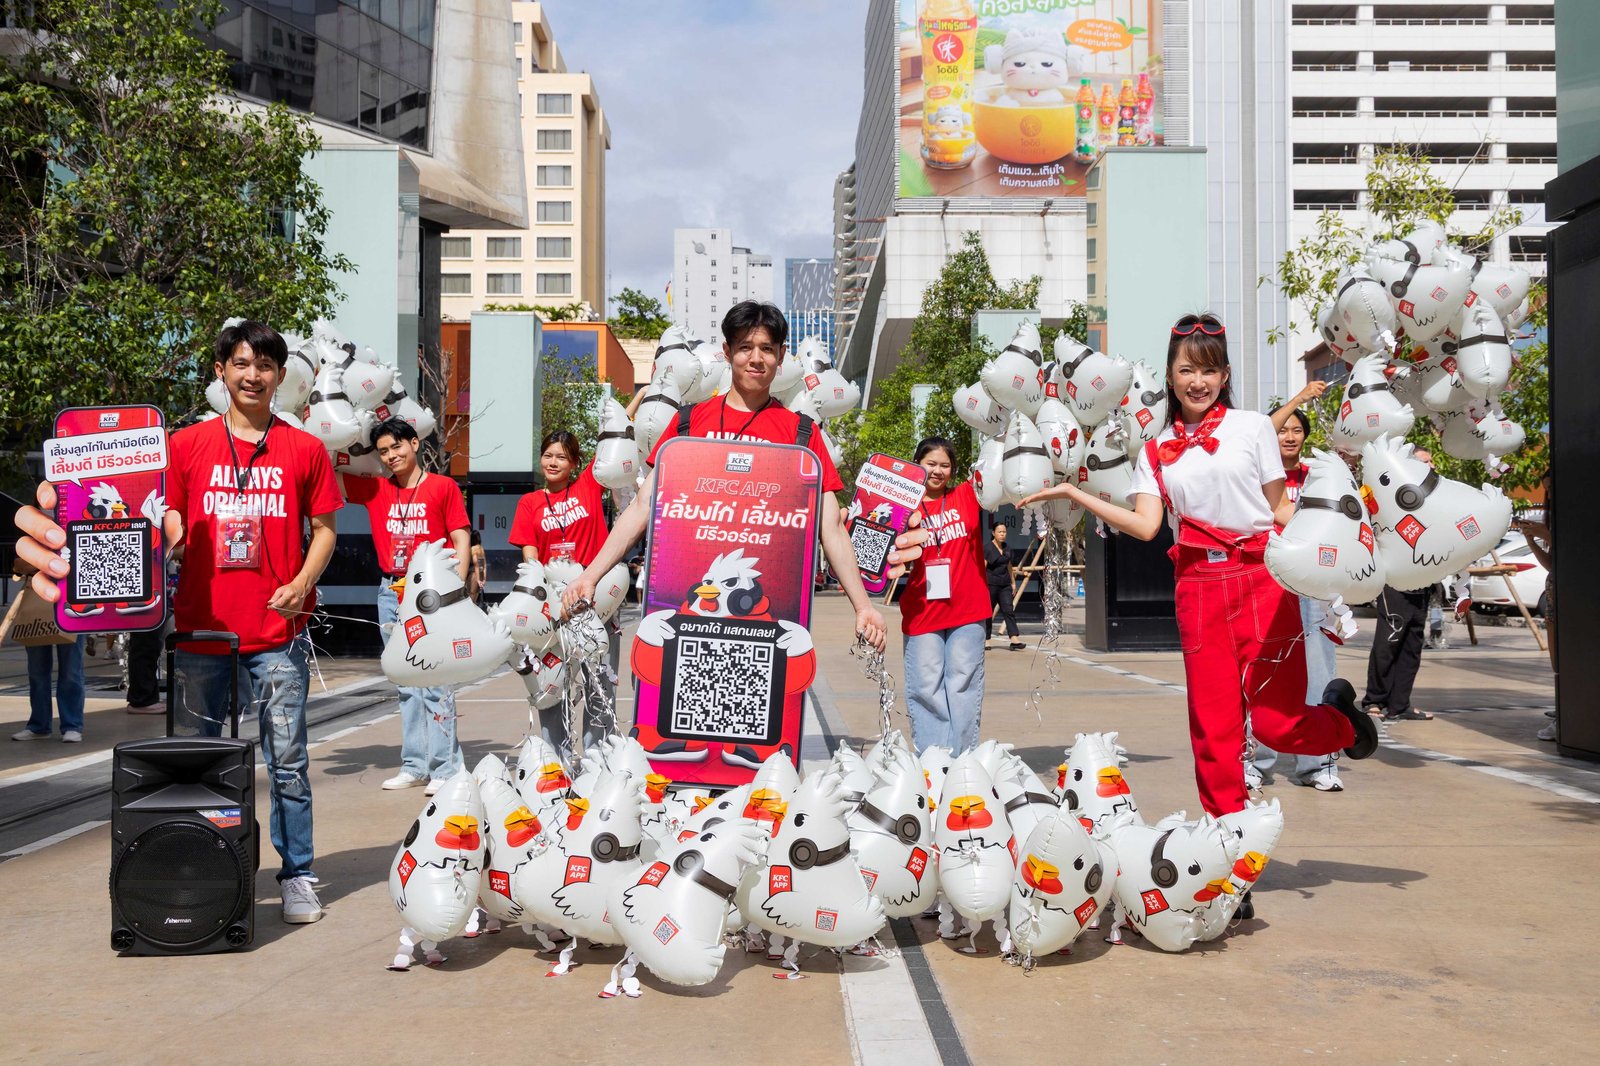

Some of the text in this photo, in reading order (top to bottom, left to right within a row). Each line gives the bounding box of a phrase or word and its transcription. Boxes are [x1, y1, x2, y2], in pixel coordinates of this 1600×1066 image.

[50, 435, 160, 457] เลี้ยงลูกไก่ในกำมือ(ถือ)
[51, 451, 161, 475] เลี้ยงดี มีรีวอร์ดส
[732, 457, 749, 465] KFC
[695, 477, 781, 498] KFC APP
[388, 503, 427, 518] ALWAYS
[661, 492, 810, 529] เลี้ยงไก่ เลี้ยงดี
[93, 523, 113, 531] KFC
[113, 522, 131, 530] APP
[1402, 521, 1417, 535] KFC
[695, 525, 772, 546] มีรีวอร์ดส
[1408, 527, 1420, 540] APP
[408, 623, 421, 632] KFC
[410, 629, 423, 638] APP
[680, 621, 776, 638] อยากได้ แสกนเลย!
[401, 860, 411, 873] KFC
[910, 863, 922, 872] APP
[912, 856, 925, 866] KFC
[570, 865, 588, 873] KFC
[649, 868, 663, 878] KFC
[645, 874, 659, 883] APP
[772, 874, 789, 882] KFC
[1144, 896, 1155, 910] APP
[1149, 894, 1162, 909] KFC
[1080, 903, 1093, 917] KFC
